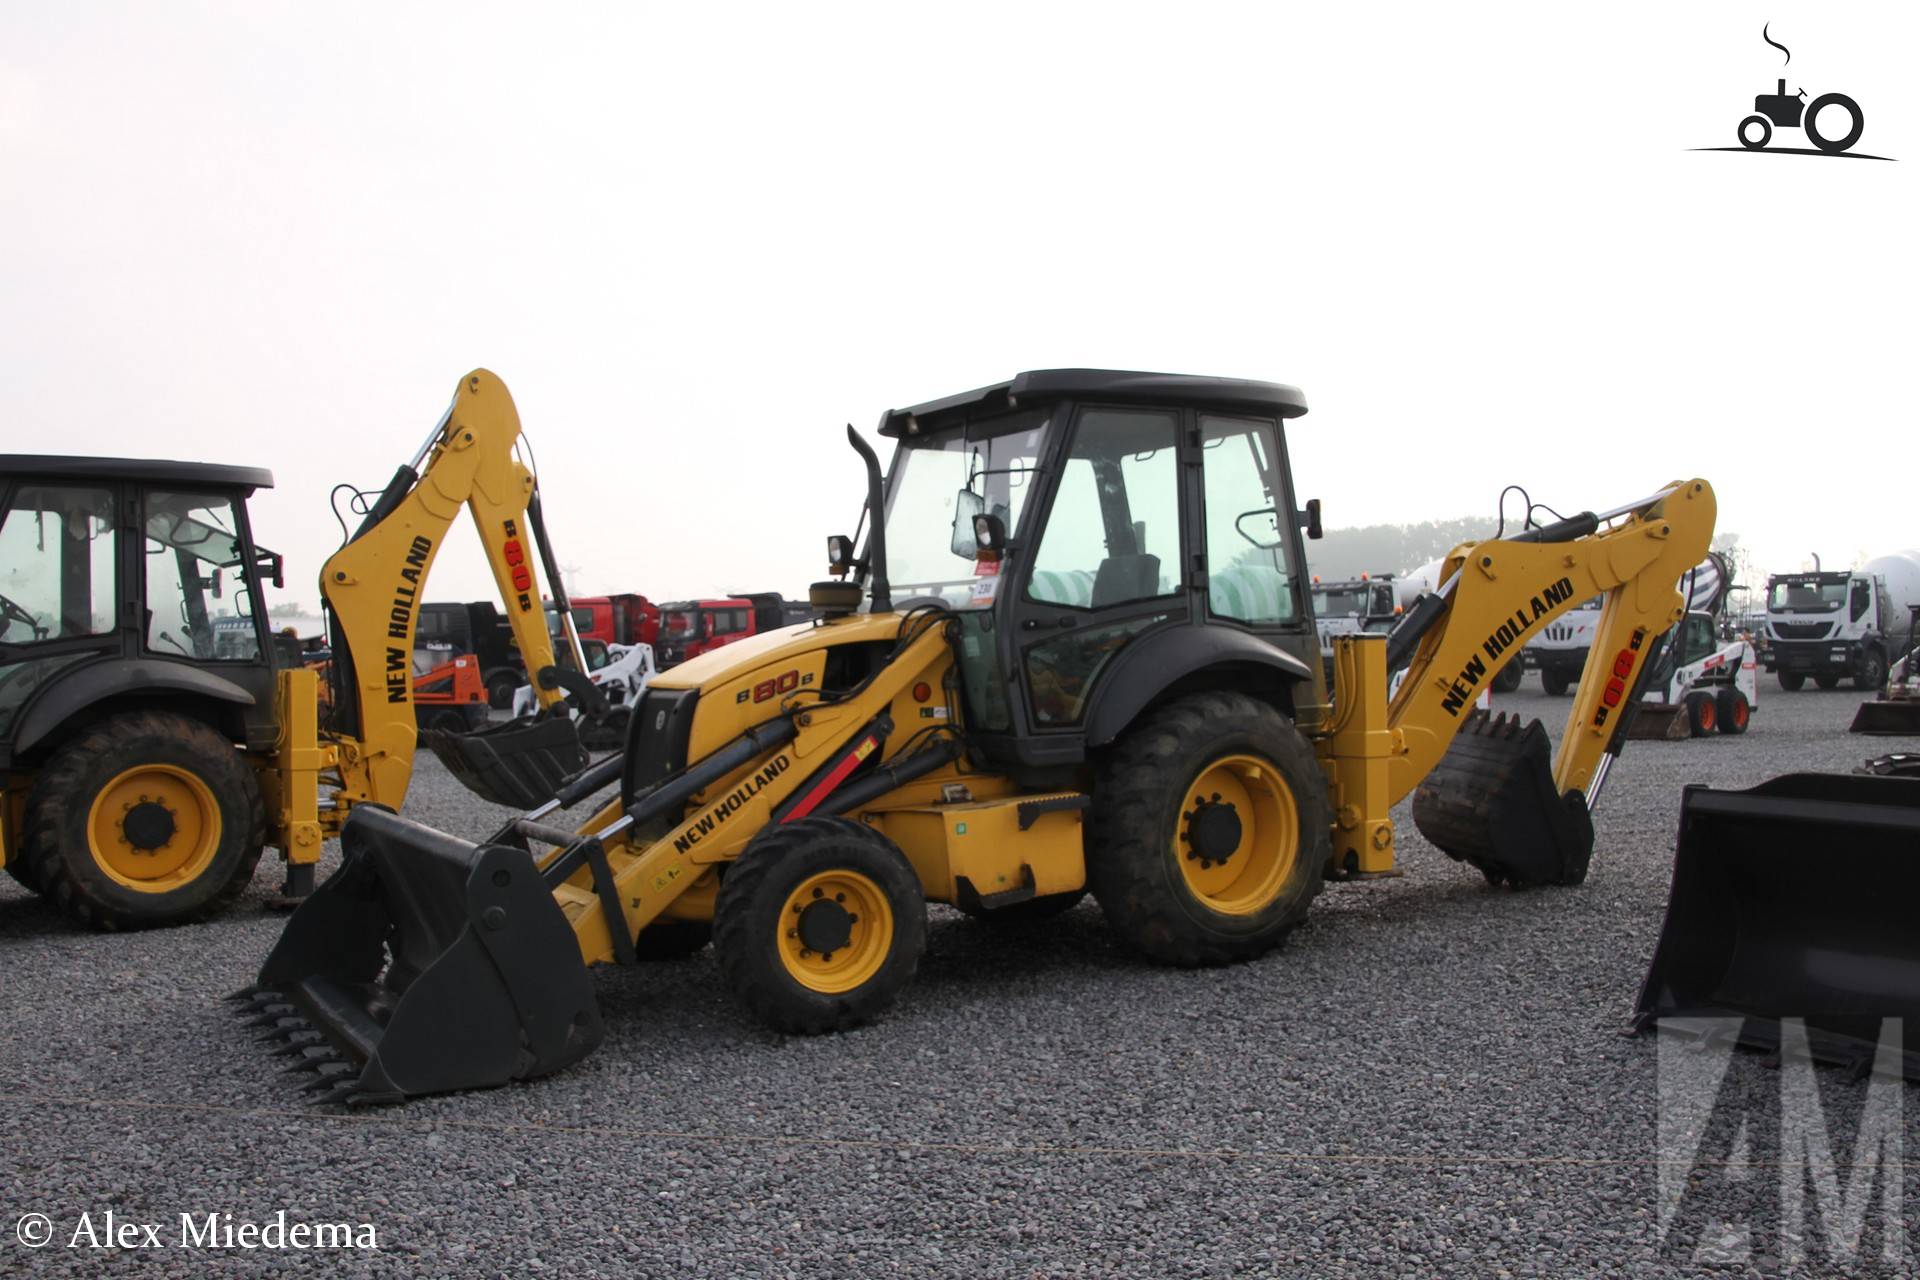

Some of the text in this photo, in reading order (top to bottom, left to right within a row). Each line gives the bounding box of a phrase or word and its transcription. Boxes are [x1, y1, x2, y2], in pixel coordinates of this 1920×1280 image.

[386, 535, 432, 703] NEW HOLLAND
[1441, 577, 1574, 717] NEW HOLLAND
[673, 755, 790, 854] NEW HOLLAND
